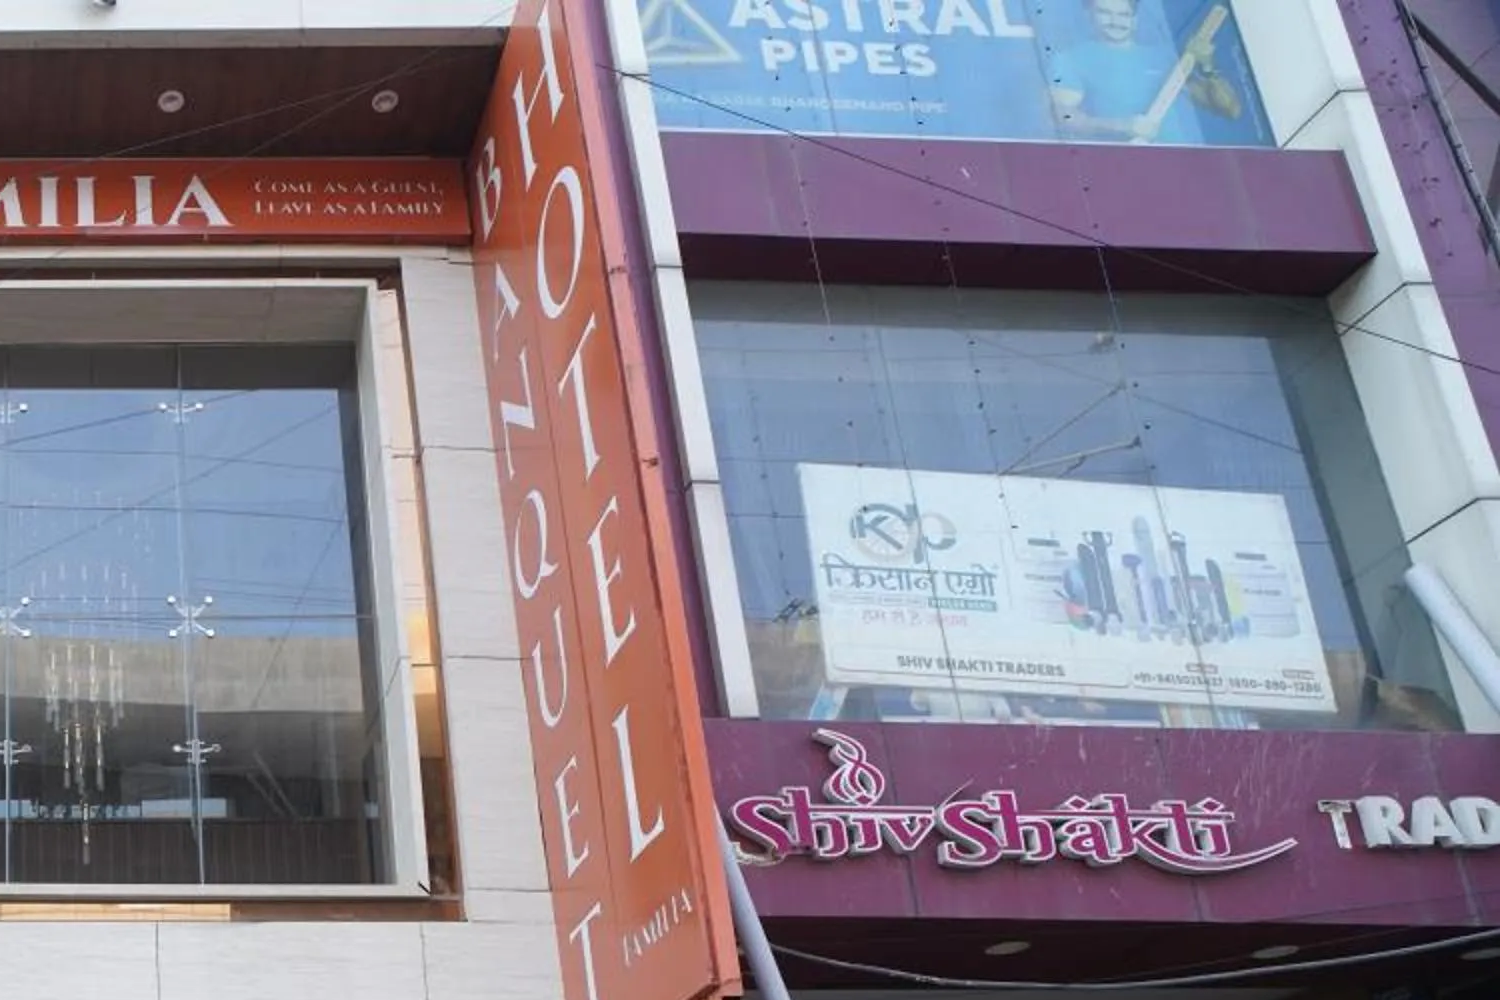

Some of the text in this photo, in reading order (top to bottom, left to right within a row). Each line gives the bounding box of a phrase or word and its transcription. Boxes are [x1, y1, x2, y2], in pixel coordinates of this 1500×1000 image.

[727, 0, 1034, 38] ASTRAL
[760, 40, 938, 78] PIPES
[897, 655, 1066, 677] SHIV SHAKTI TRADERS
